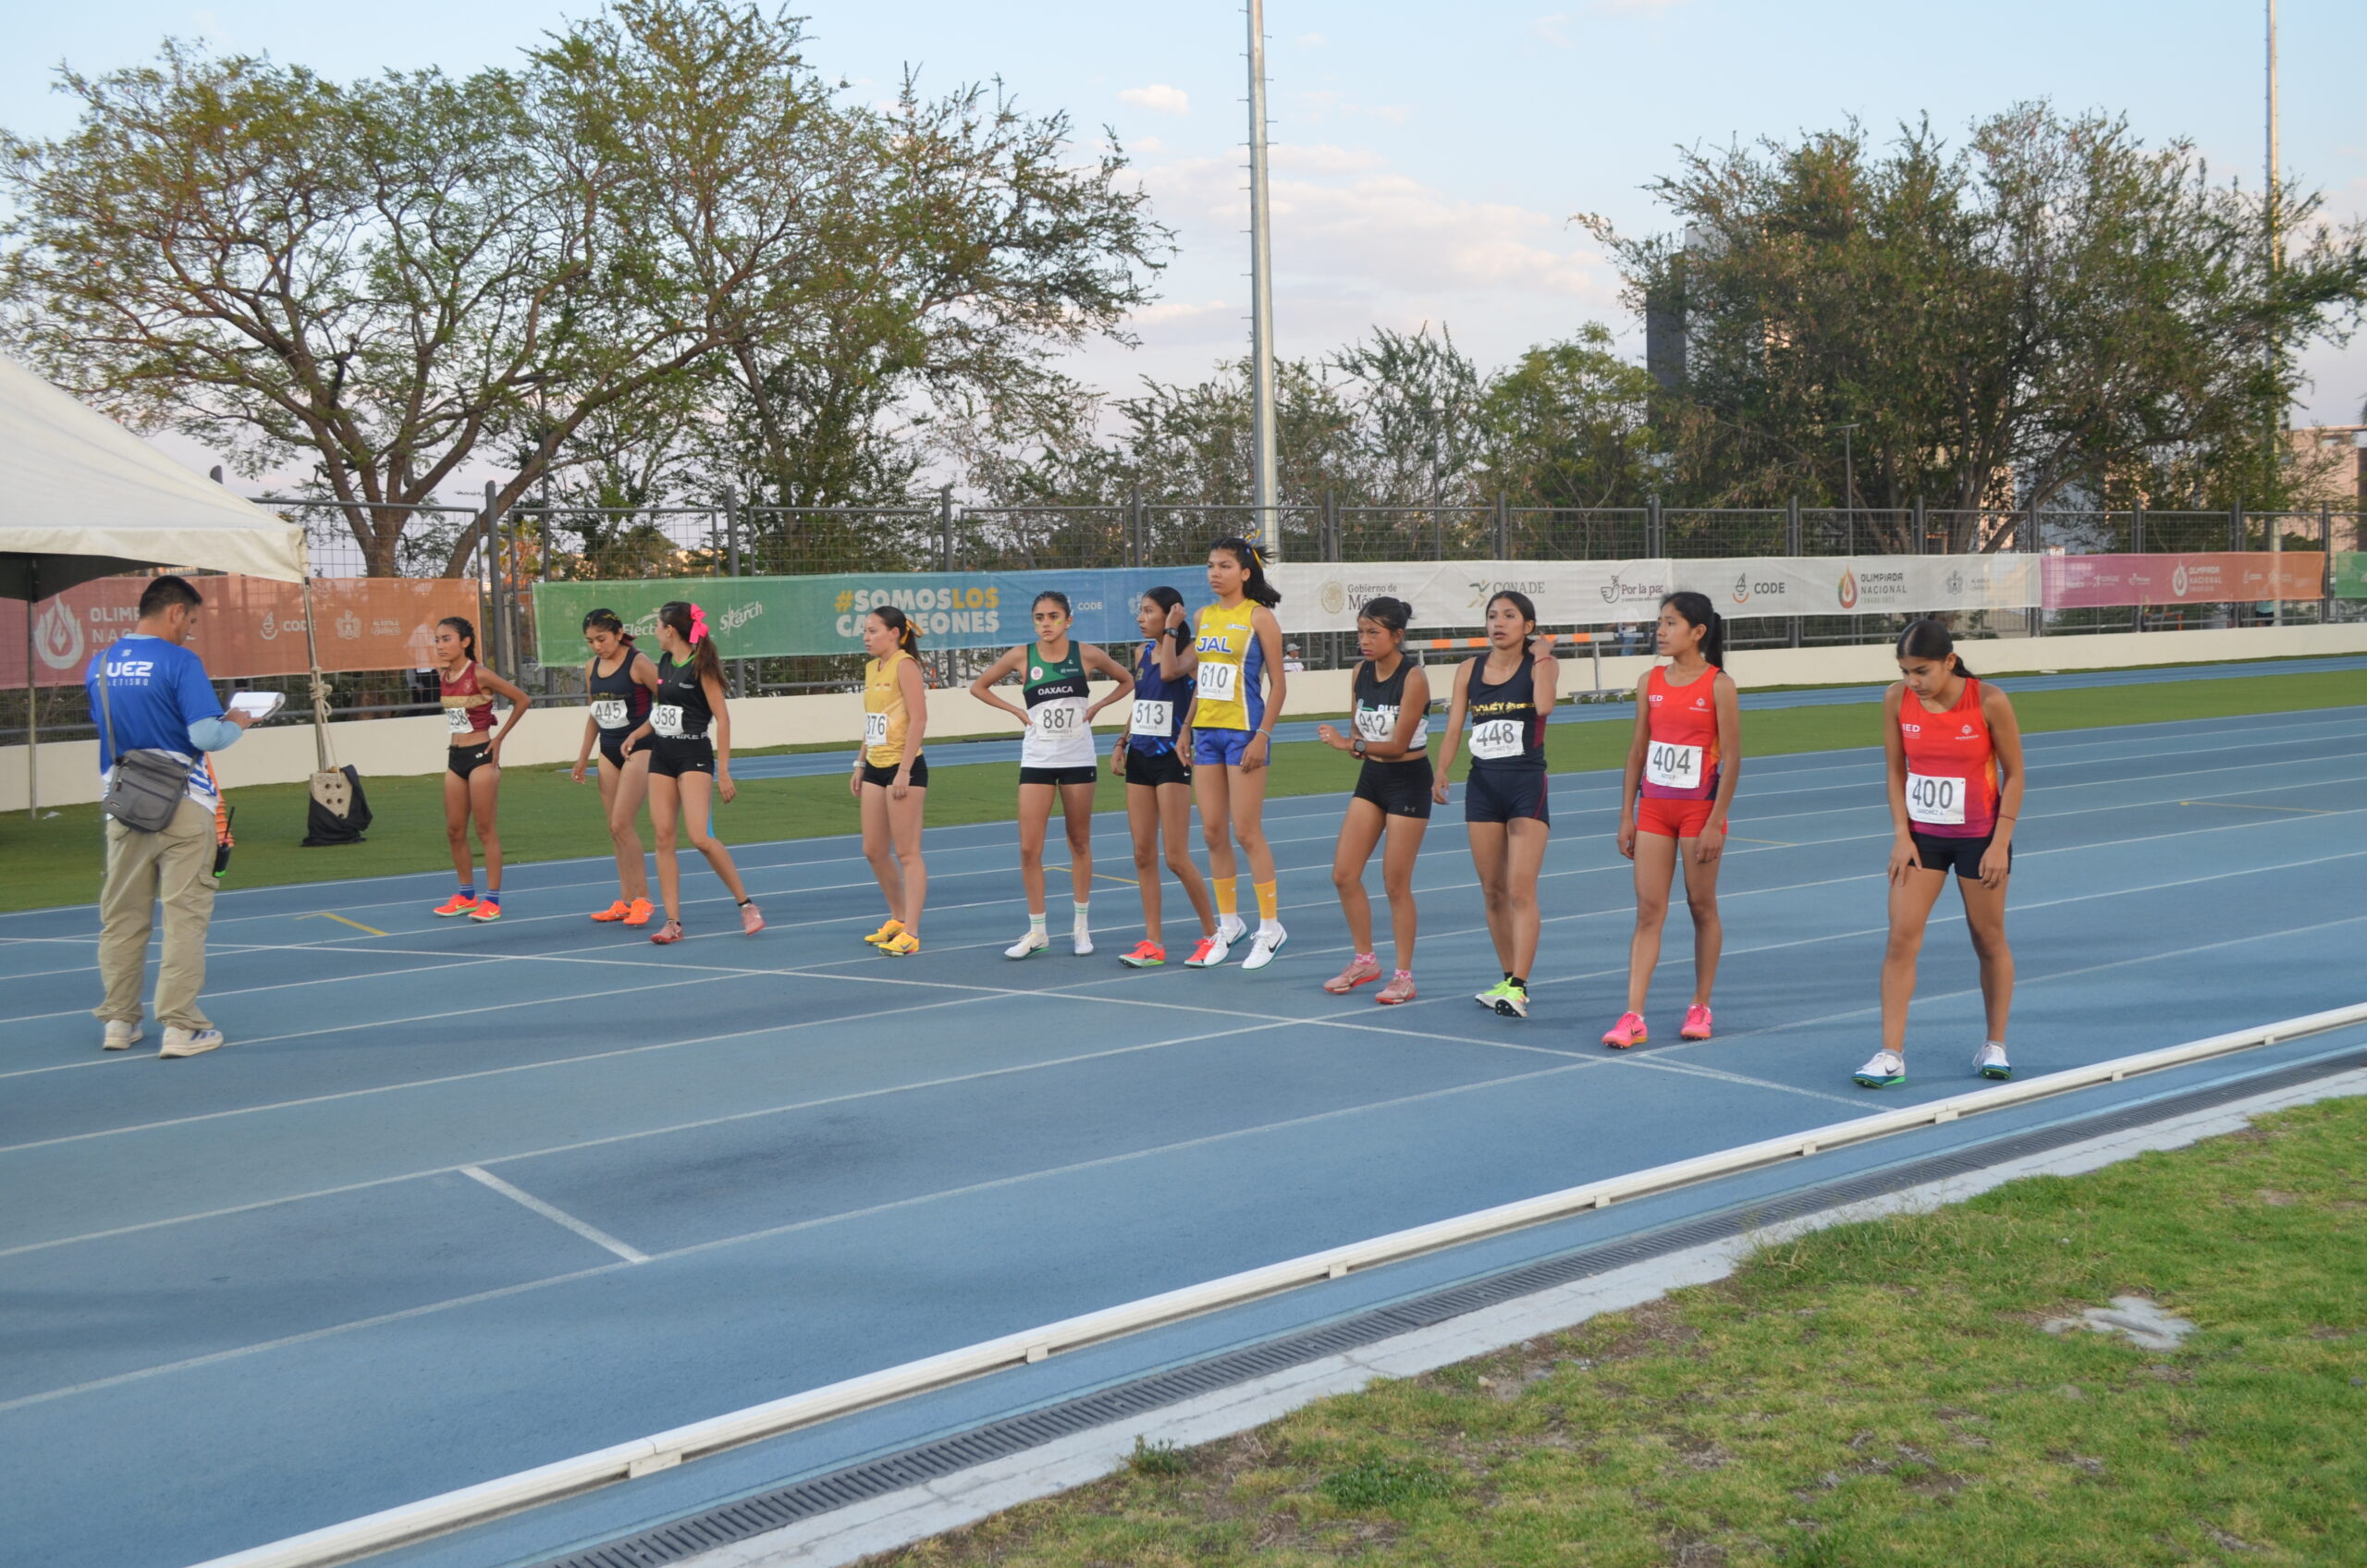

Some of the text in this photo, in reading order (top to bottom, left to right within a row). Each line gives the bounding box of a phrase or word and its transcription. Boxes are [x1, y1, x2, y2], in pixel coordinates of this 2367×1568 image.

[1860, 572, 1903, 582] OLIMPIADA
[1347, 582, 1397, 593] Gobierno de
[1493, 582, 1545, 594] CONADE
[1621, 583, 1637, 594] Por
[1638, 582, 1646, 594] la
[1754, 582, 1785, 594] CODE
[1860, 584, 1907, 594] NACIONAL
[835, 587, 1000, 613] #SOMOSLOS
[1077, 601, 1103, 611] CODE
[90, 606, 141, 622] OLIMP
[623, 623, 657, 636] Elect
[836, 610, 1000, 638] CAEONES
[1196, 637, 1233, 654] JAL
[95, 660, 154, 678] UEZ
[1200, 664, 1229, 689] 610
[97, 678, 149, 687] ETISMO
[1037, 685, 1073, 696] OAXACA
[595, 703, 621, 721] 445
[654, 707, 677, 727] 358
[1043, 707, 1075, 729] 887
[1135, 702, 1164, 725] 513
[1359, 712, 1389, 736] 912
[1476, 722, 1515, 747] 448
[1652, 745, 1691, 775] 404
[1912, 778, 1954, 809] 400
